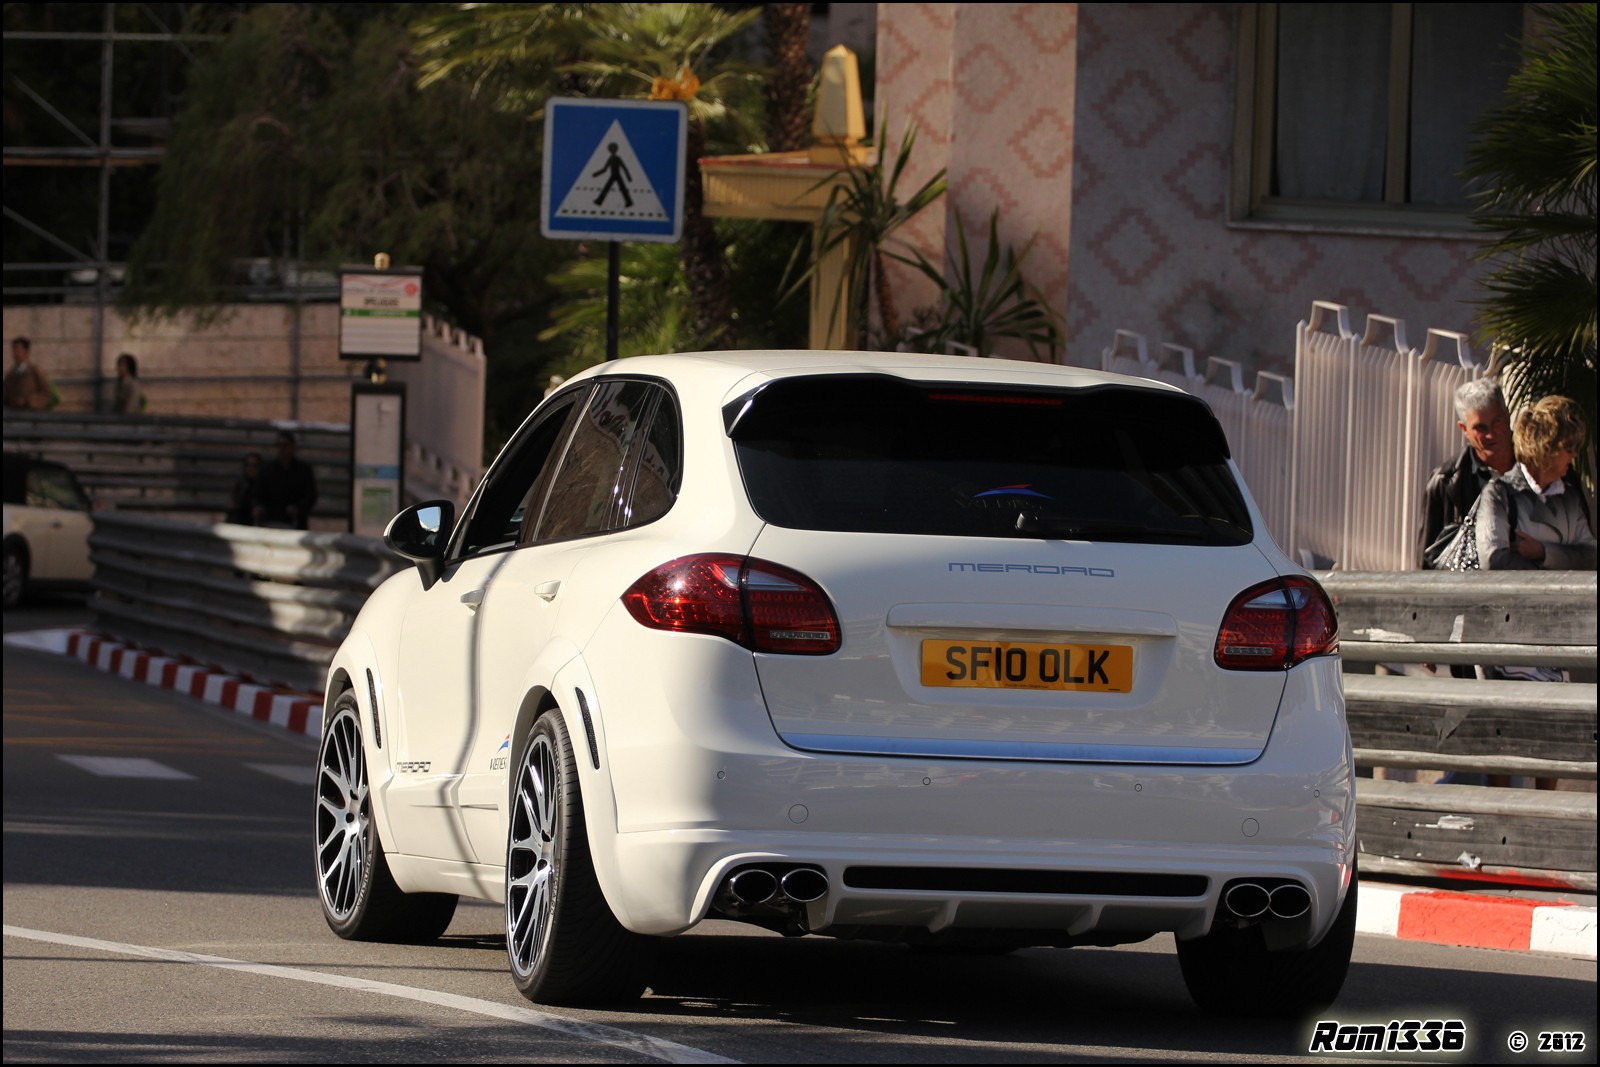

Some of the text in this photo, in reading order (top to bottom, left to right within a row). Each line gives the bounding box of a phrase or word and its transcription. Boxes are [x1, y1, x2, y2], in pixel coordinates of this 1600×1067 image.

[948, 562, 1115, 578] MERDAD
[945, 646, 1110, 685] SF10 OLK
